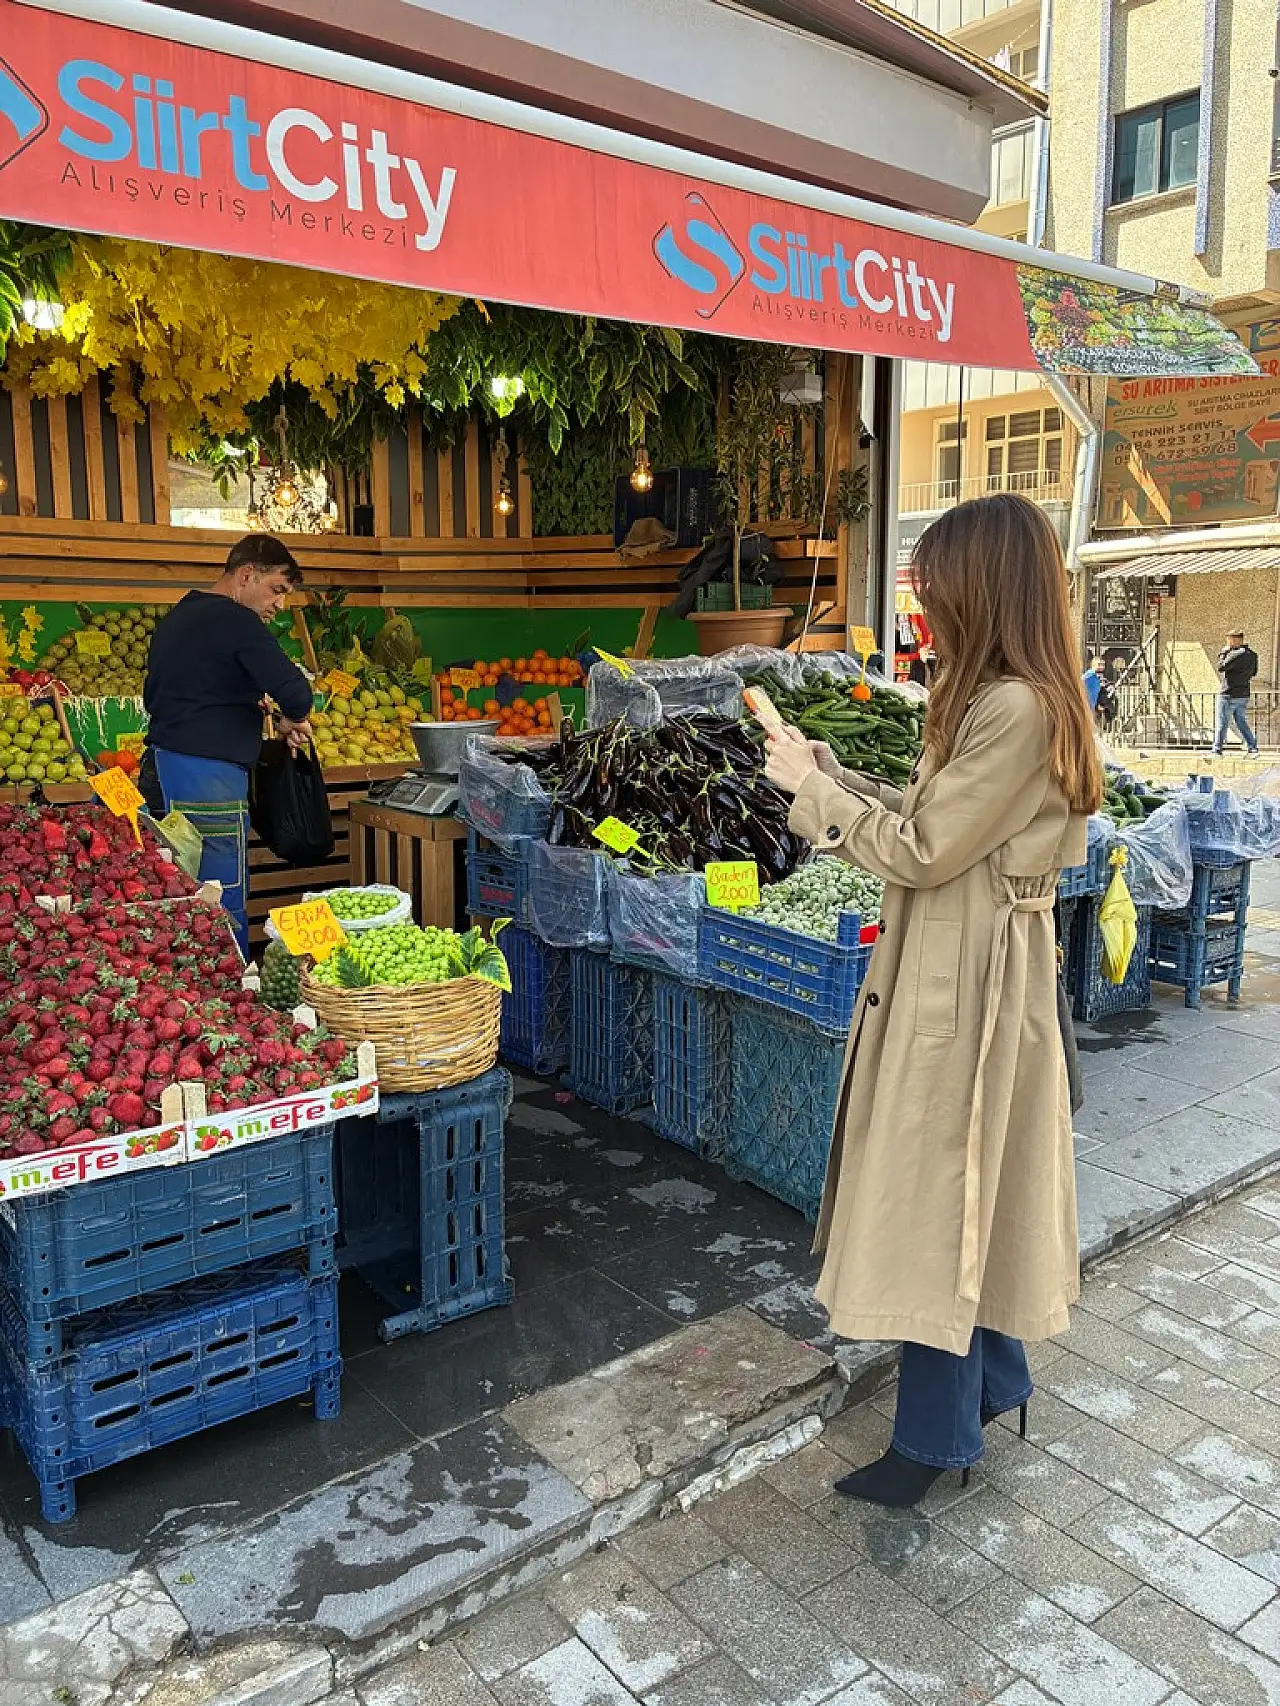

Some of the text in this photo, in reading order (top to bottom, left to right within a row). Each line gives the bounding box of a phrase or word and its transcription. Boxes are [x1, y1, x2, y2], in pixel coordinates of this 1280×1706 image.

[61, 161, 407, 248] Alışveriş Merkezi
[752, 294, 934, 340] Alışveriş Merkezi
[1158, 435, 1186, 447] 223
